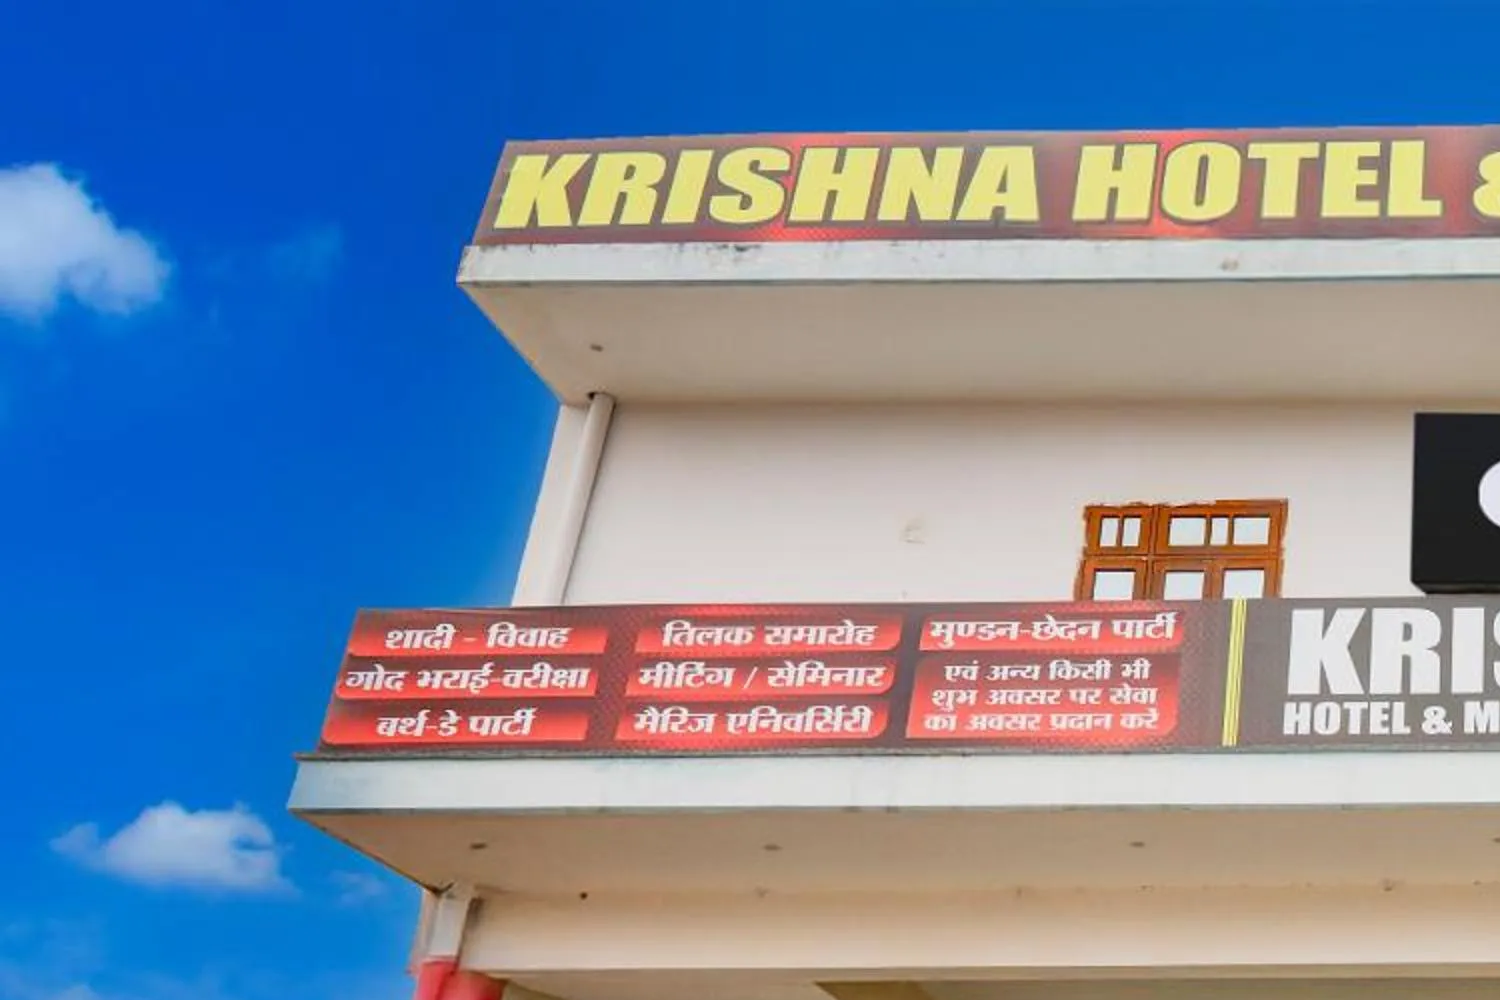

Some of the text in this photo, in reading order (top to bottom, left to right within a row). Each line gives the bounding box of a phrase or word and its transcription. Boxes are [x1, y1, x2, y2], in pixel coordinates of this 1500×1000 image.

[493, 144, 1041, 230] KRISHNA
[1071, 140, 1444, 223] HOTEL
[384, 623, 456, 650] शादी
[486, 621, 573, 648] विवाह
[661, 619, 878, 647] तिलक समारोह
[1111, 611, 1180, 640] पार्टी
[345, 663, 409, 692] गोद
[766, 660, 888, 688] सेमिनार
[943, 658, 1152, 682] एवं अन्य किसी भी
[931, 682, 1159, 712] शुभ अवसर पर सेवा
[468, 707, 538, 736] पार्टी
[633, 705, 718, 735] मैरिज
[964, 712, 1043, 732] अवसर
[1049, 713, 1113, 731] प्रदान
[1283, 701, 1411, 736] HOTEL
[1421, 704, 1453, 734] &
